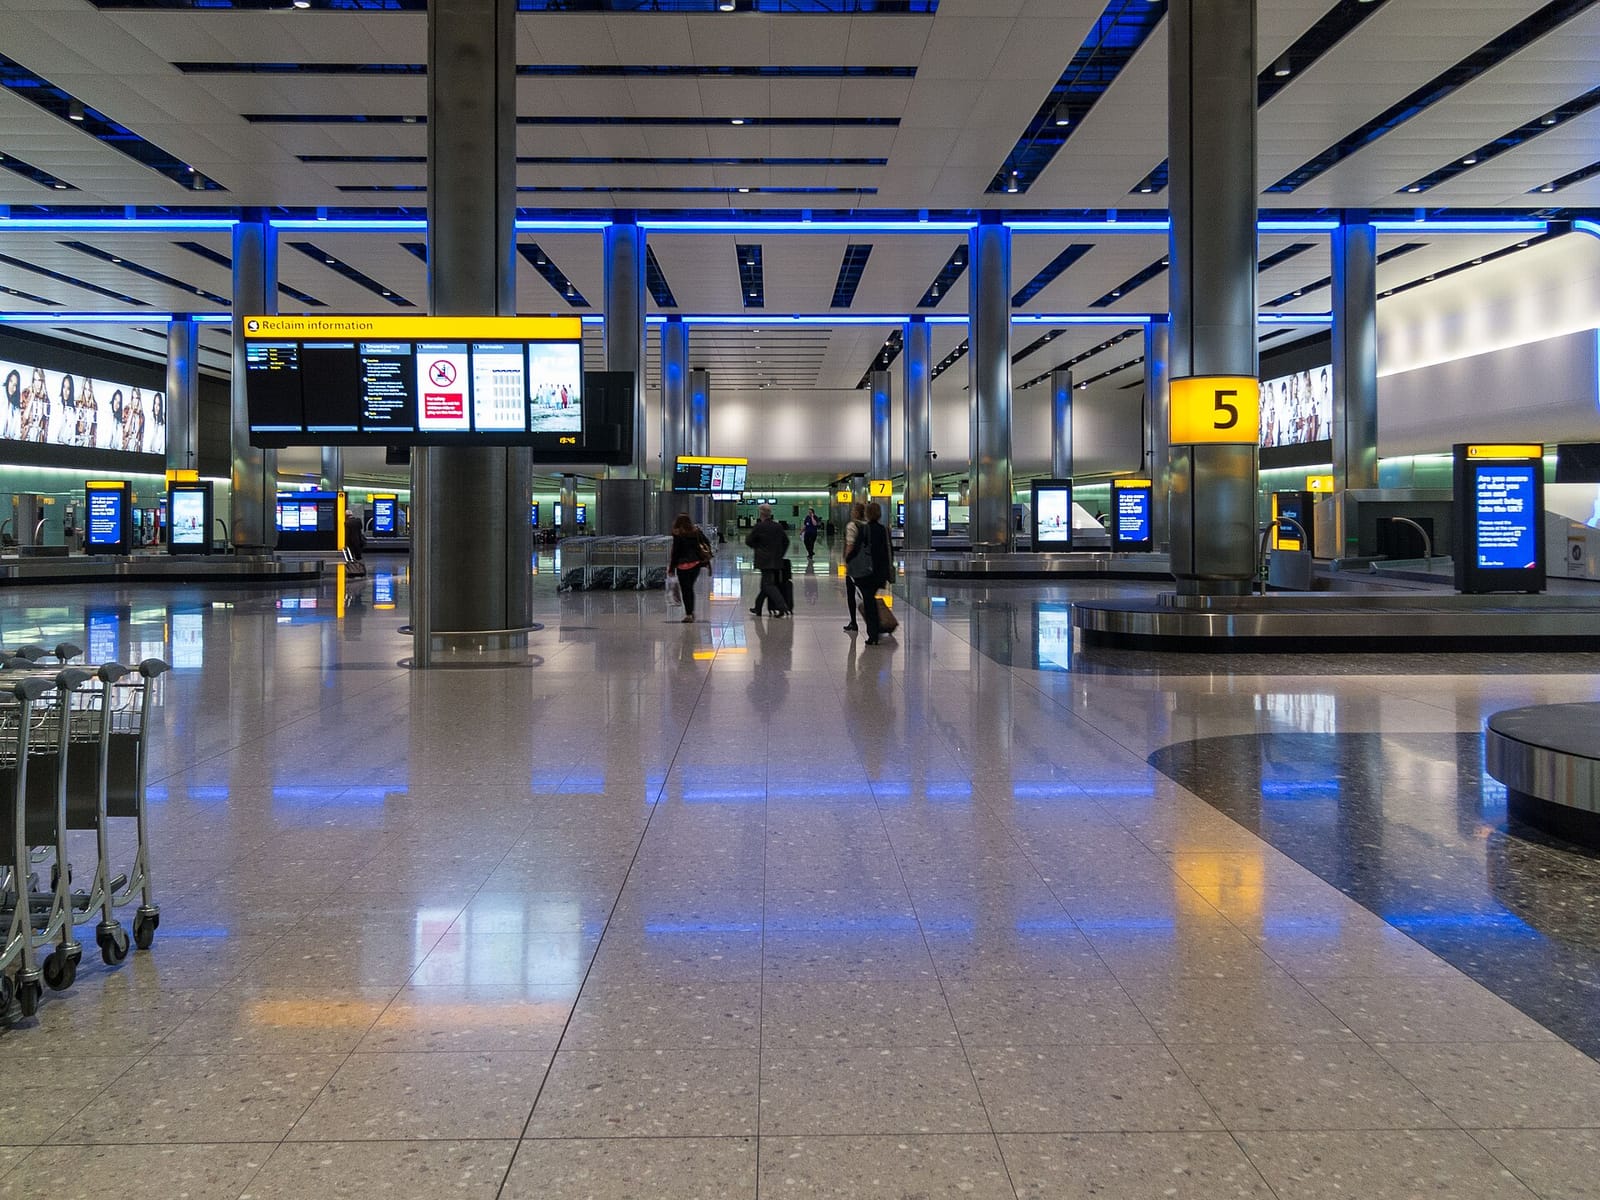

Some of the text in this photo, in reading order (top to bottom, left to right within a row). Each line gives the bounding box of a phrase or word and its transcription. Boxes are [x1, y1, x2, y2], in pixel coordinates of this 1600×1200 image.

[262, 320, 373, 330] Reclaim information
[1213, 390, 1239, 429] 5
[879, 483, 886, 493] 7
